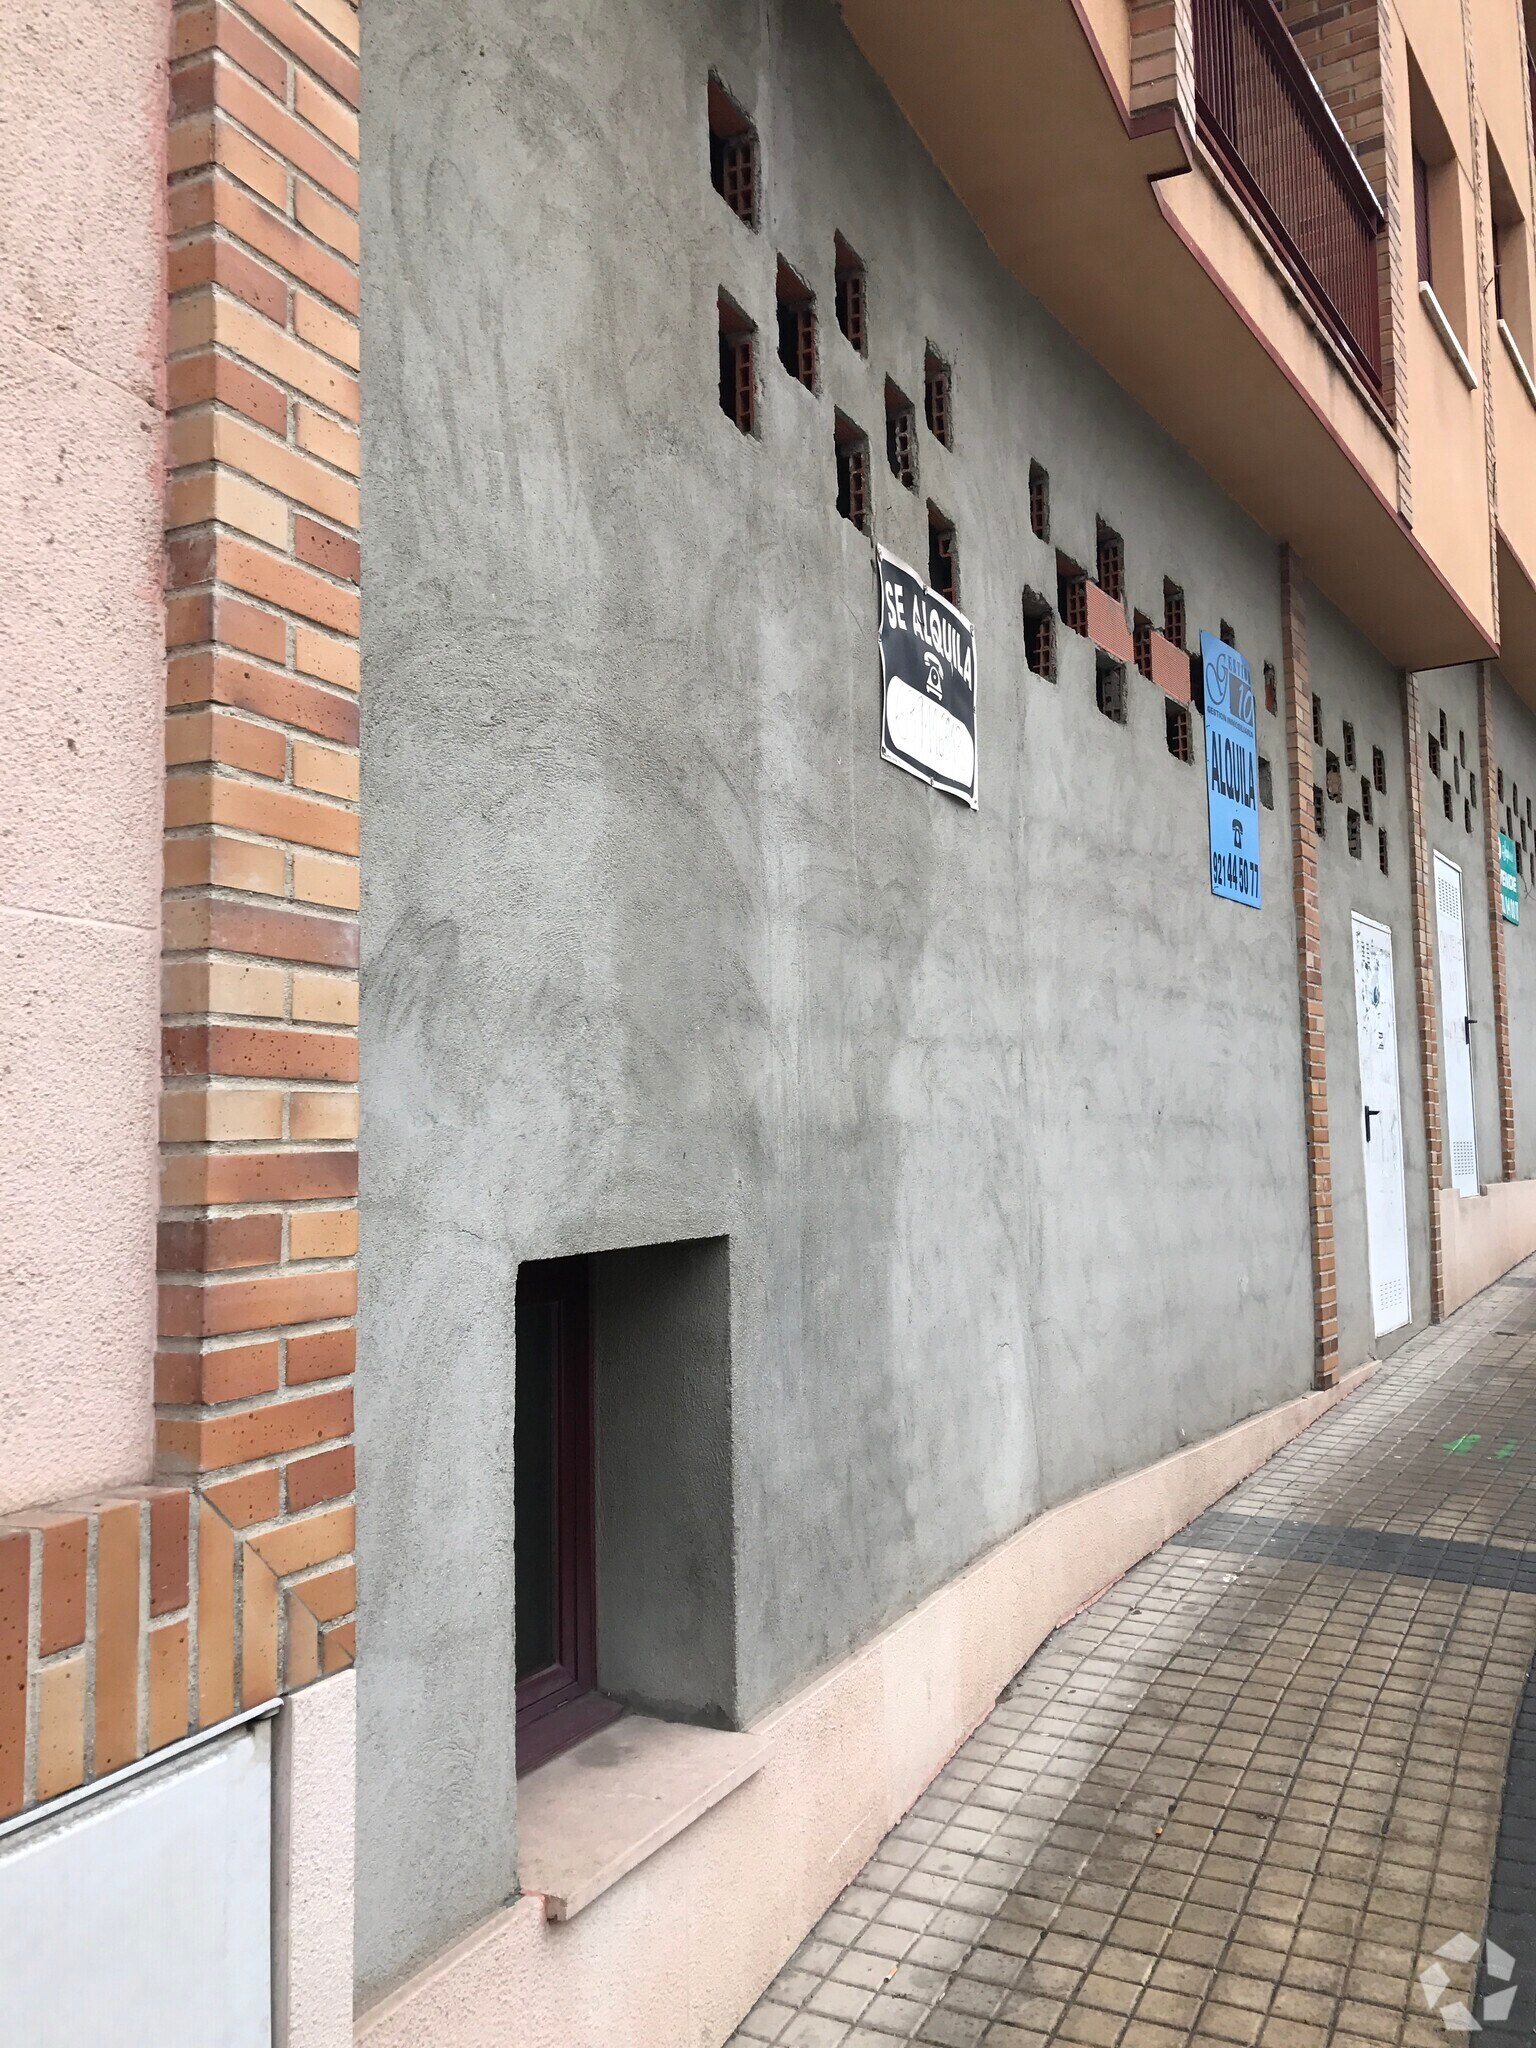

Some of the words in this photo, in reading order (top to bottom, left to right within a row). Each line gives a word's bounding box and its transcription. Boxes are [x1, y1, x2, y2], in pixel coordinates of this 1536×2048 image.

[884, 580, 908, 631] SE
[912, 594, 973, 691] ALQUILA
[1211, 731, 1257, 811] ALQUILA
